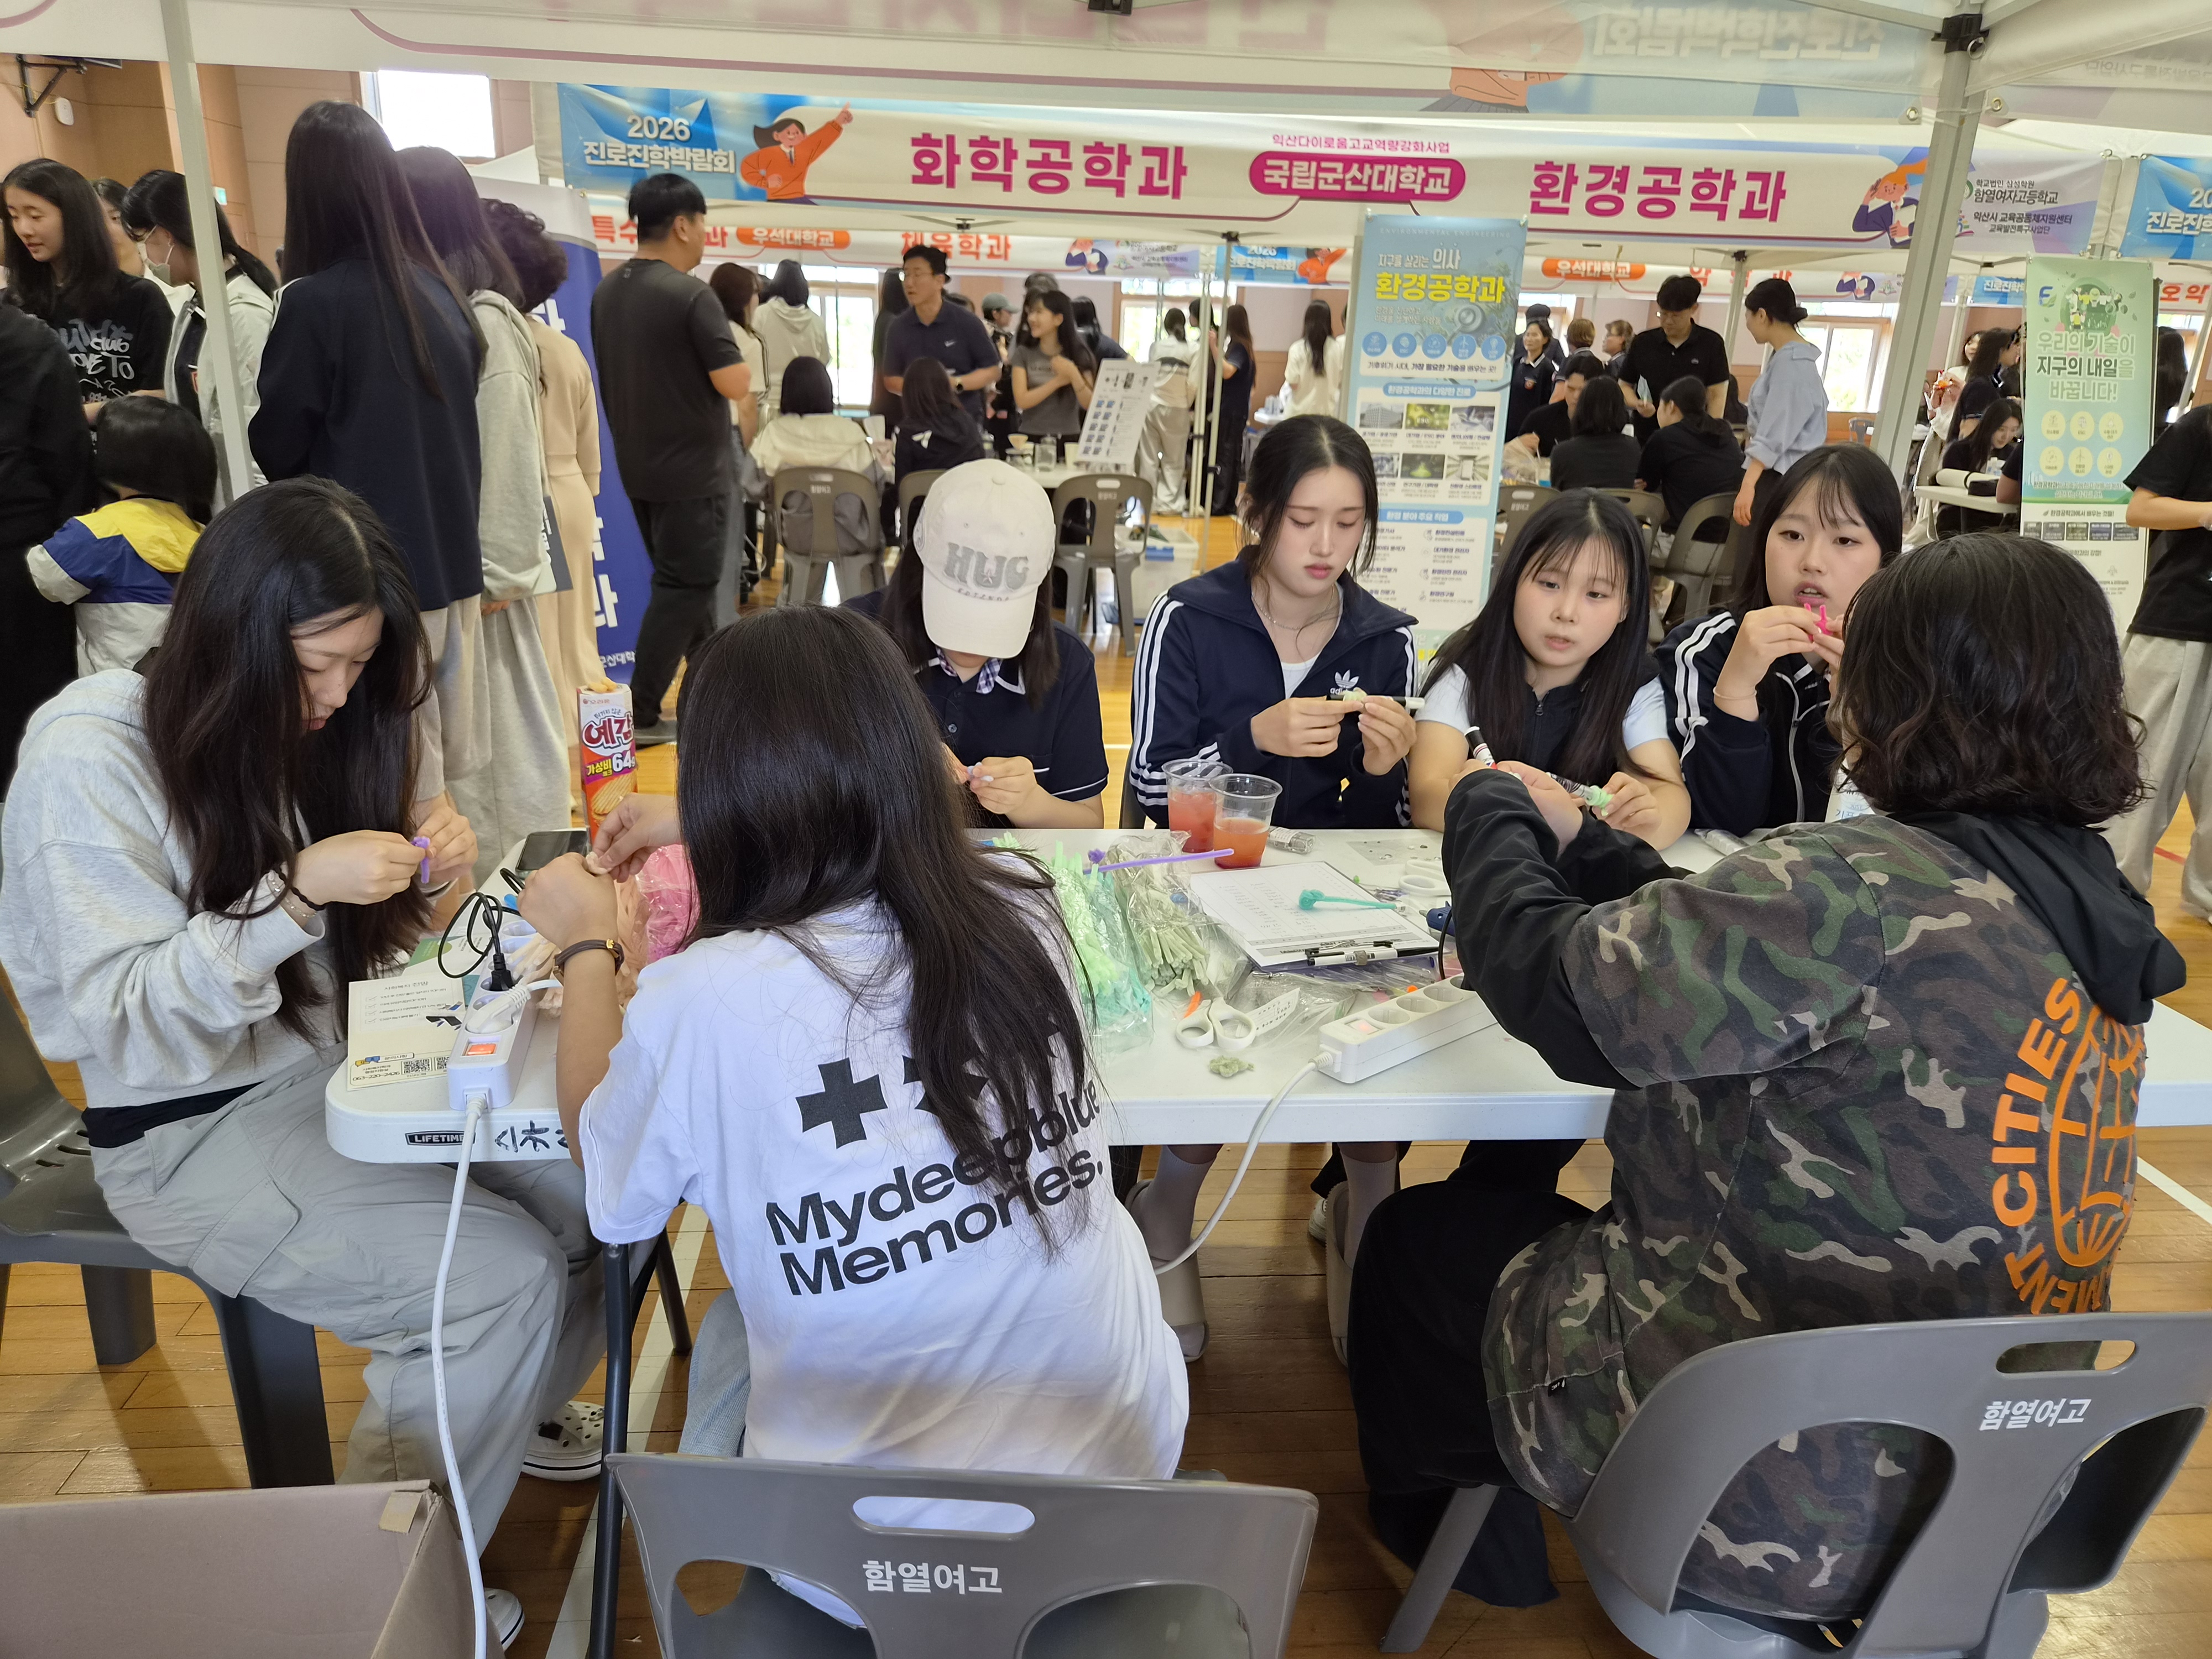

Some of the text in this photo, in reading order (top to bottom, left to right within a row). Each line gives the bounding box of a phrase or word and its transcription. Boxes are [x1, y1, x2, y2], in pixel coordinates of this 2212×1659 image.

[627, 114, 691, 142] 2026
[583, 141, 736, 174] 진로진학박람회
[911, 132, 1188, 200] 화학공학과
[1264, 159, 1452, 194] 국립군산대학교
[1976, 179, 2004, 188] 학교법인
[1529, 160, 1787, 222] 환경공학과
[1974, 189, 2058, 205] 함열여자고등학교
[1974, 211, 1998, 222] 익산시
[752, 228, 834, 248] 우석대학교
[1432, 248, 1461, 270] 의사
[1556, 262, 1631, 278] 우석대학교
[1375, 272, 1505, 304] 환경공학과
[2037, 332, 2135, 354] 우리의 기술이
[100, 351, 135, 380] TO
[2037, 357, 2135, 379] 지구의 내일을
[2049, 380, 2118, 401] 바꿉니다!
[942, 542, 1030, 591] HUG
[584, 713, 633, 745] 예감
[586, 758, 612, 776] 가성비
[352, 1072, 400, 1081] 063-220-2426
[1992, 978, 2081, 1227] CITIES
[1979, 1398, 2091, 1431] 함열여고
[862, 1561, 1003, 1595] 함열여고
